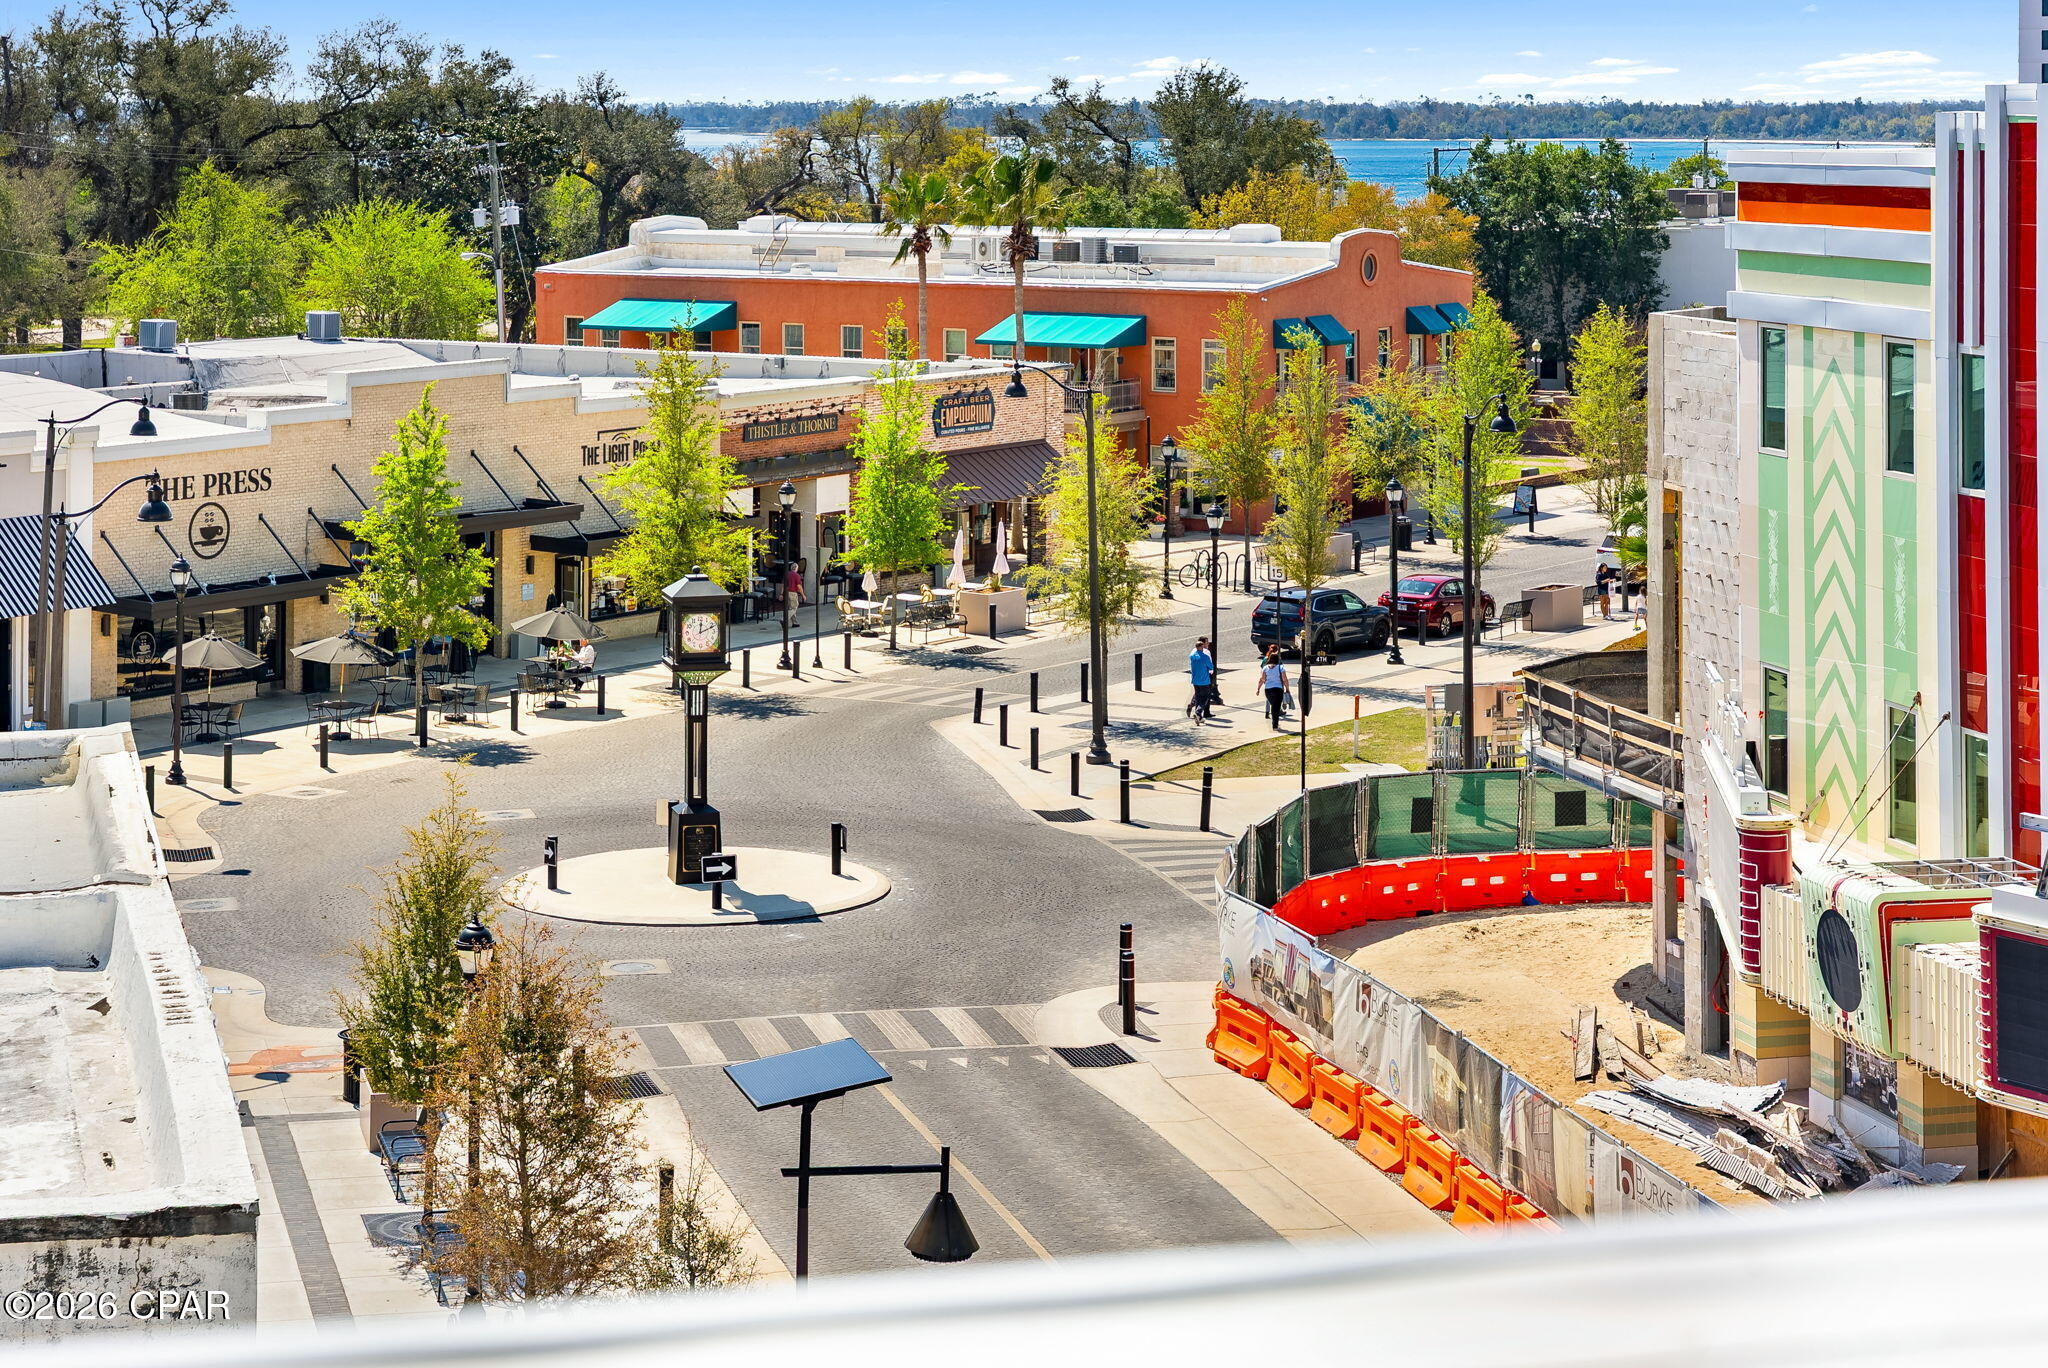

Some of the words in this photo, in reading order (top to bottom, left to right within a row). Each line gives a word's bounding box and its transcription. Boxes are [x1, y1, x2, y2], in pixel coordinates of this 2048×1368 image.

[942, 398, 967, 406] CRAFT
[970, 395, 990, 403] BEER
[940, 403, 992, 428] EMPOURIUM
[748, 423, 788, 439] THISTLE
[789, 423, 797, 434] &
[798, 417, 836, 433] THORNE
[581, 445, 600, 467] THE
[603, 443, 630, 464] LIGHT
[202, 467, 272, 498] PRESS
[1272, 568, 1283, 578] 15
[1635, 1163, 1674, 1216] BURKE
